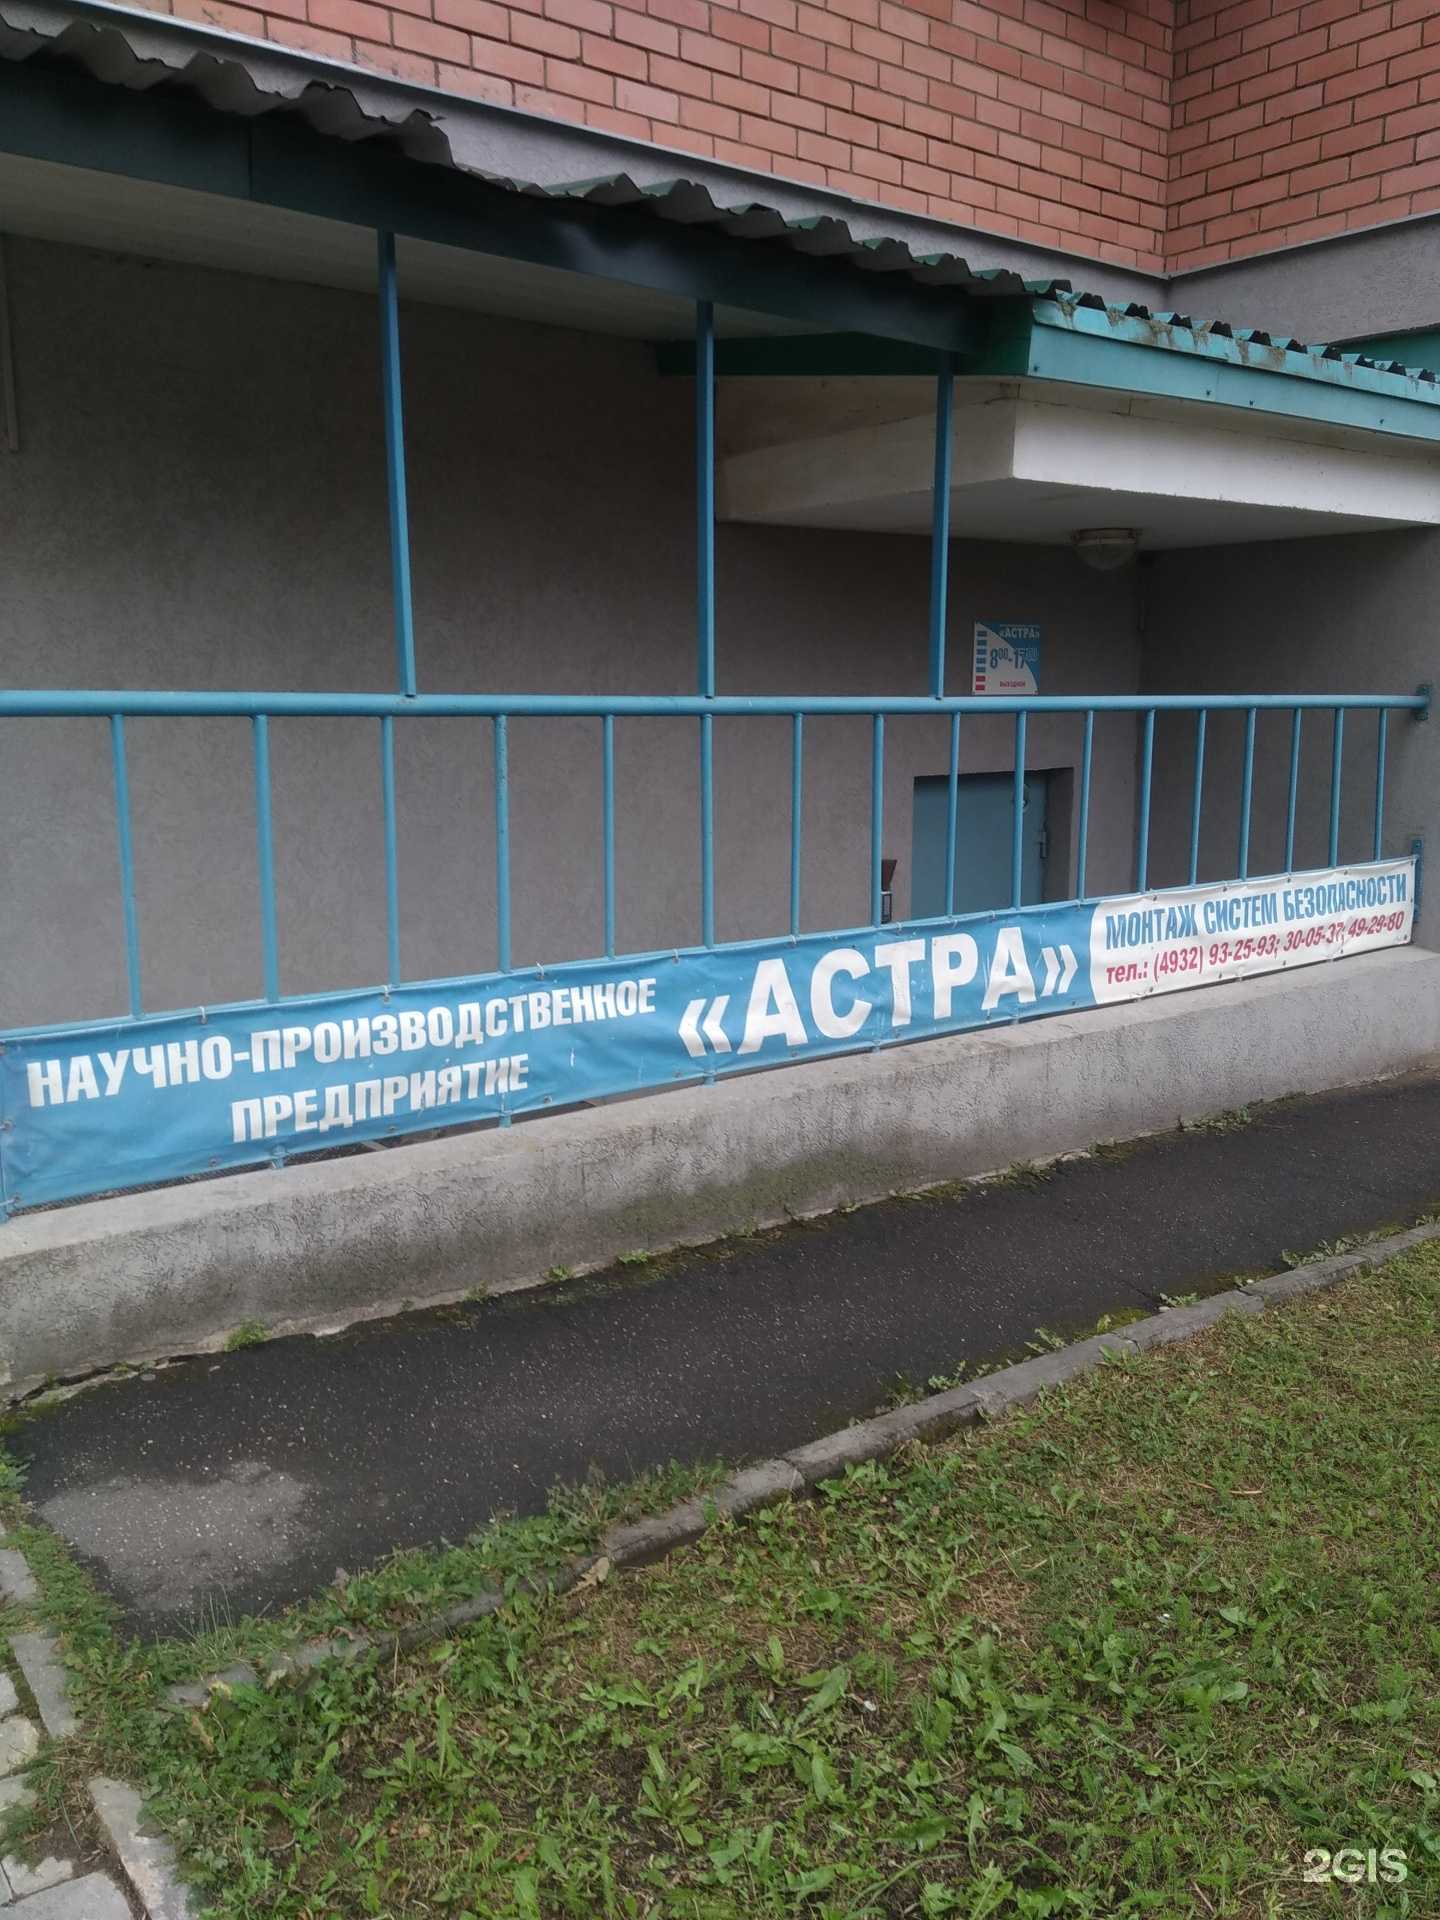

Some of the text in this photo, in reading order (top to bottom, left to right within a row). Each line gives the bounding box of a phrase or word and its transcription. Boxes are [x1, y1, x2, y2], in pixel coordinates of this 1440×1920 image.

[1105, 873, 1407, 949] МОНТАЖ СИСТЕМ БЕЗОПАСНОСТИ
[1106, 961, 1149, 984] тел.:
[1153, 945, 1204, 982] (4932)
[1348, 911, 1405, 939] 49-29-80
[678, 927, 1079, 1057] «АСТРА»
[27, 978, 656, 1108] НАУЧНО-ПРОИЗВОДСТВЕННОЕ
[231, 1053, 530, 1143] ПРЕДПРИЯТИЕ
